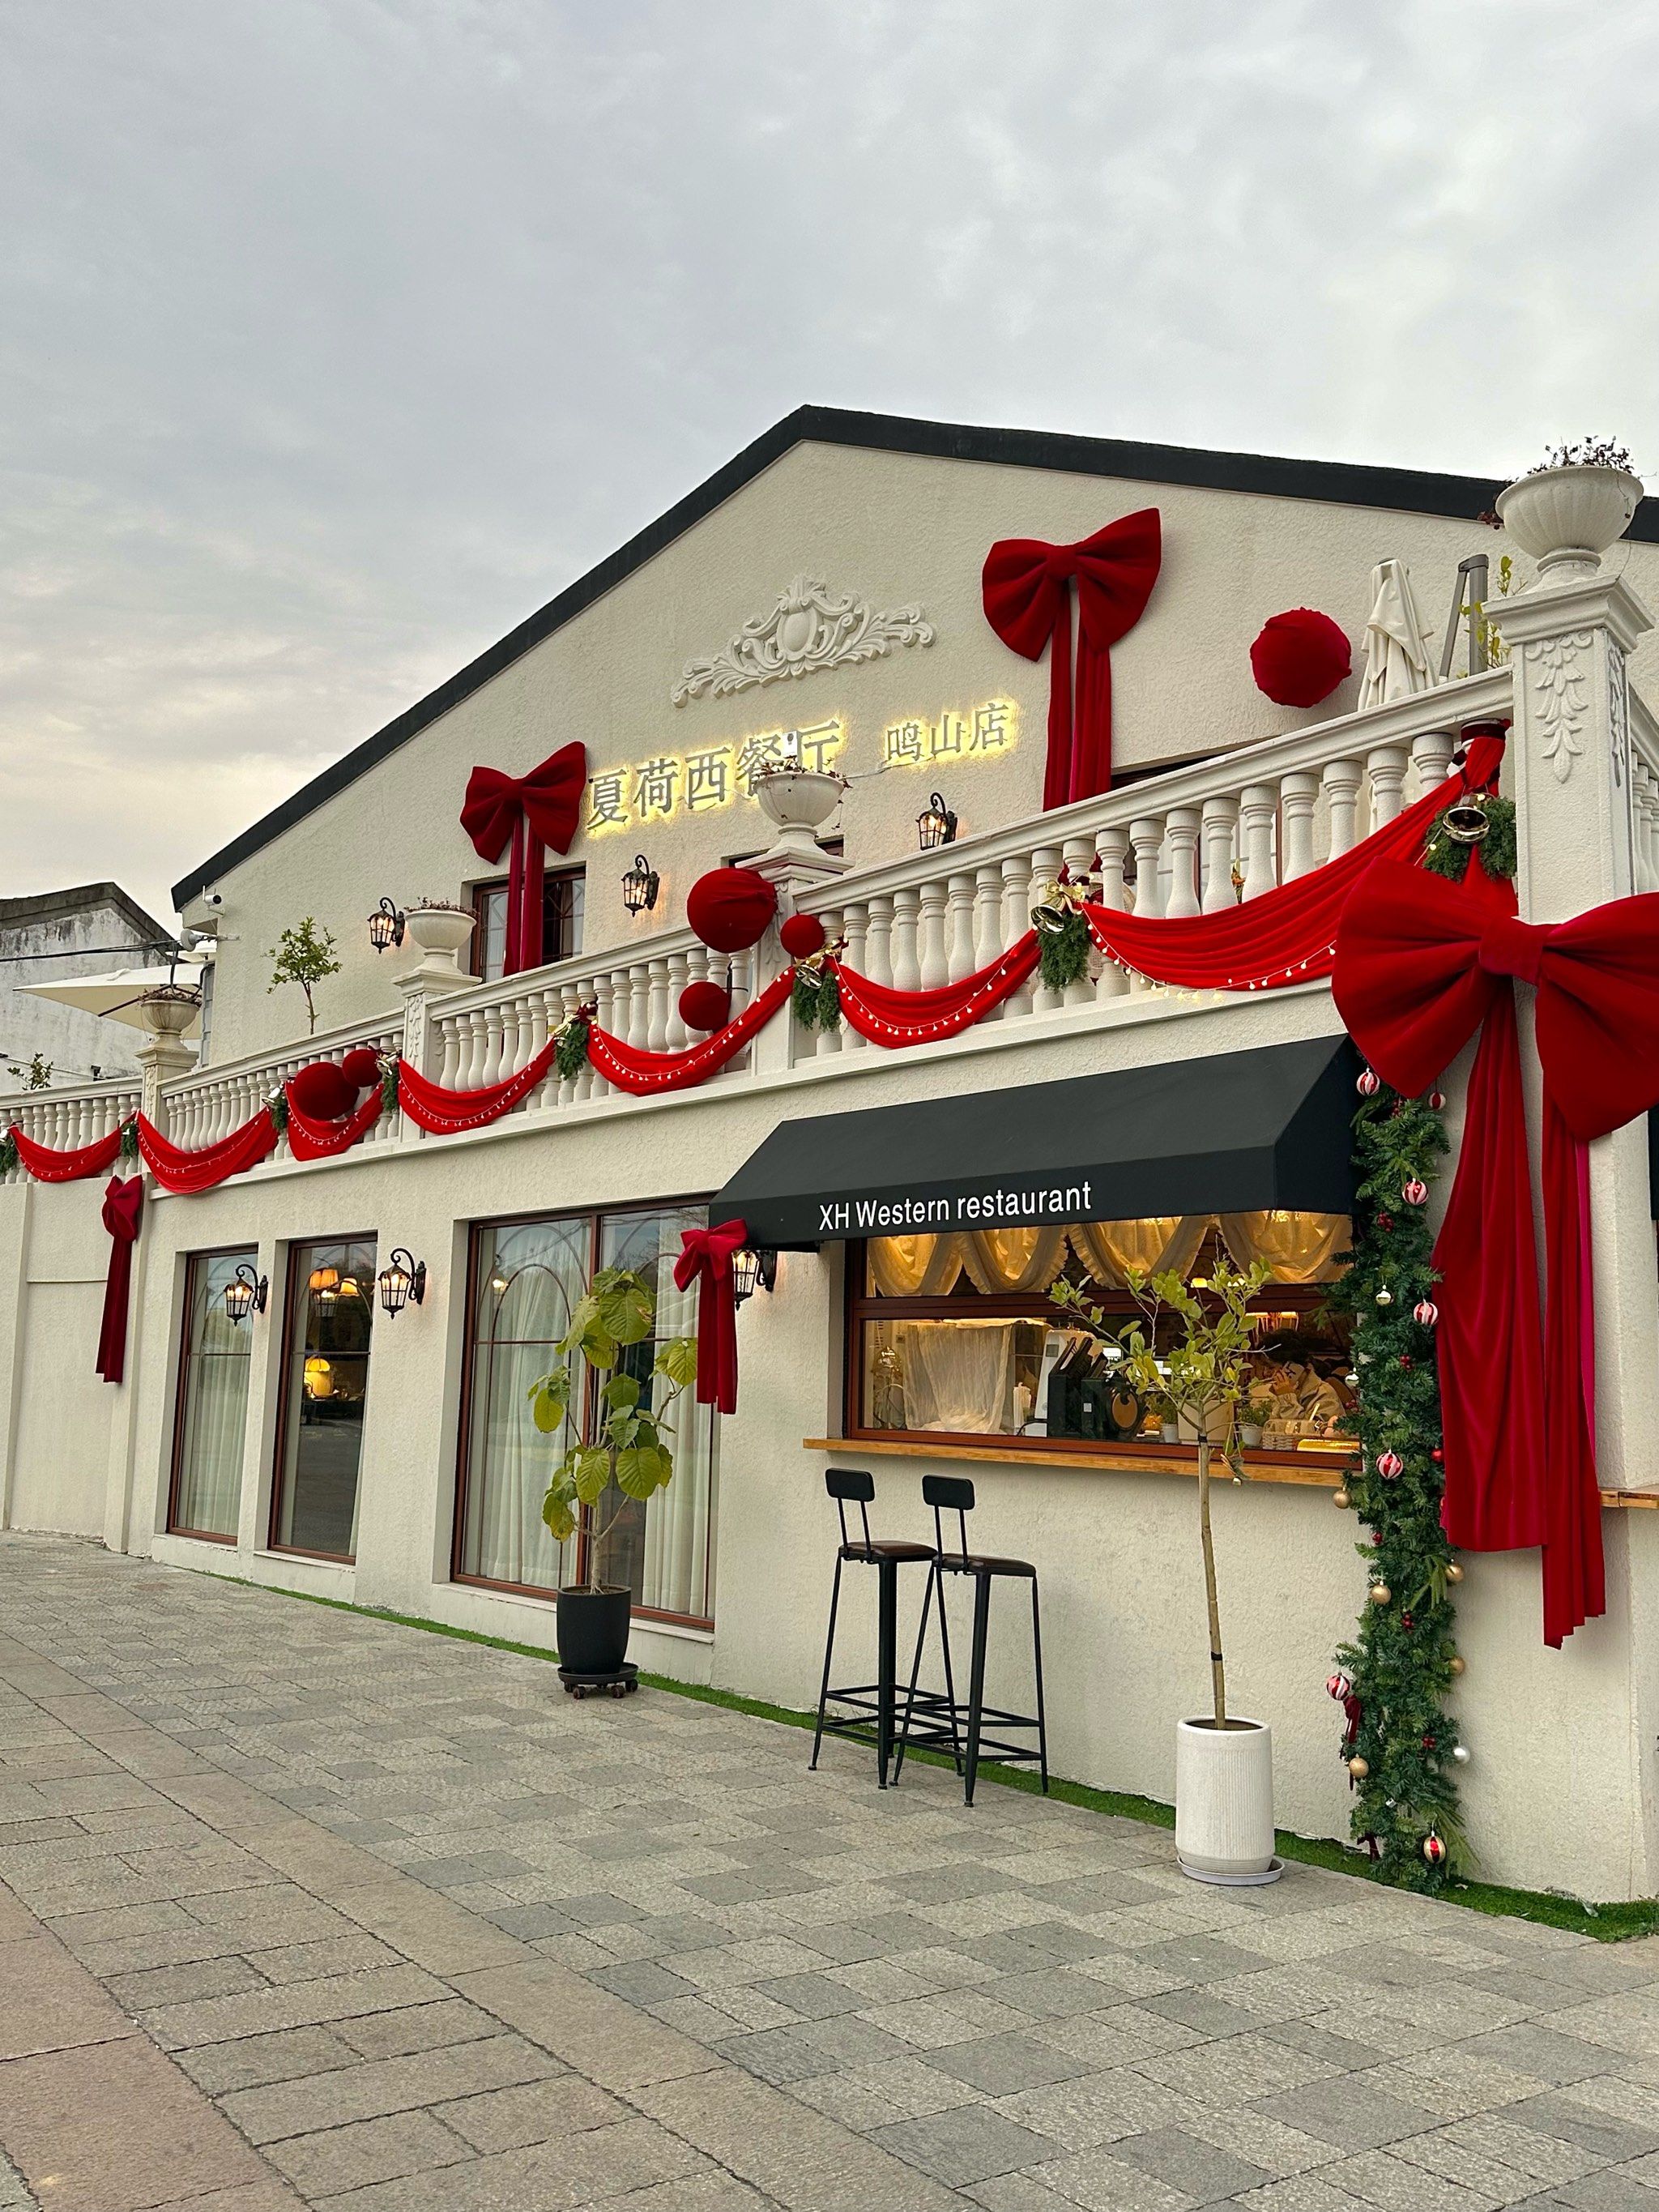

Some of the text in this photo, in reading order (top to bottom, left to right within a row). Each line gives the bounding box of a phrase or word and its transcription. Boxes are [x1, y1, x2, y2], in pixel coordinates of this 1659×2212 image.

[587, 702, 1009, 831] 夏荷西餐厅 鸣山店
[818, 1181, 1091, 1231] XH Western restaurant
